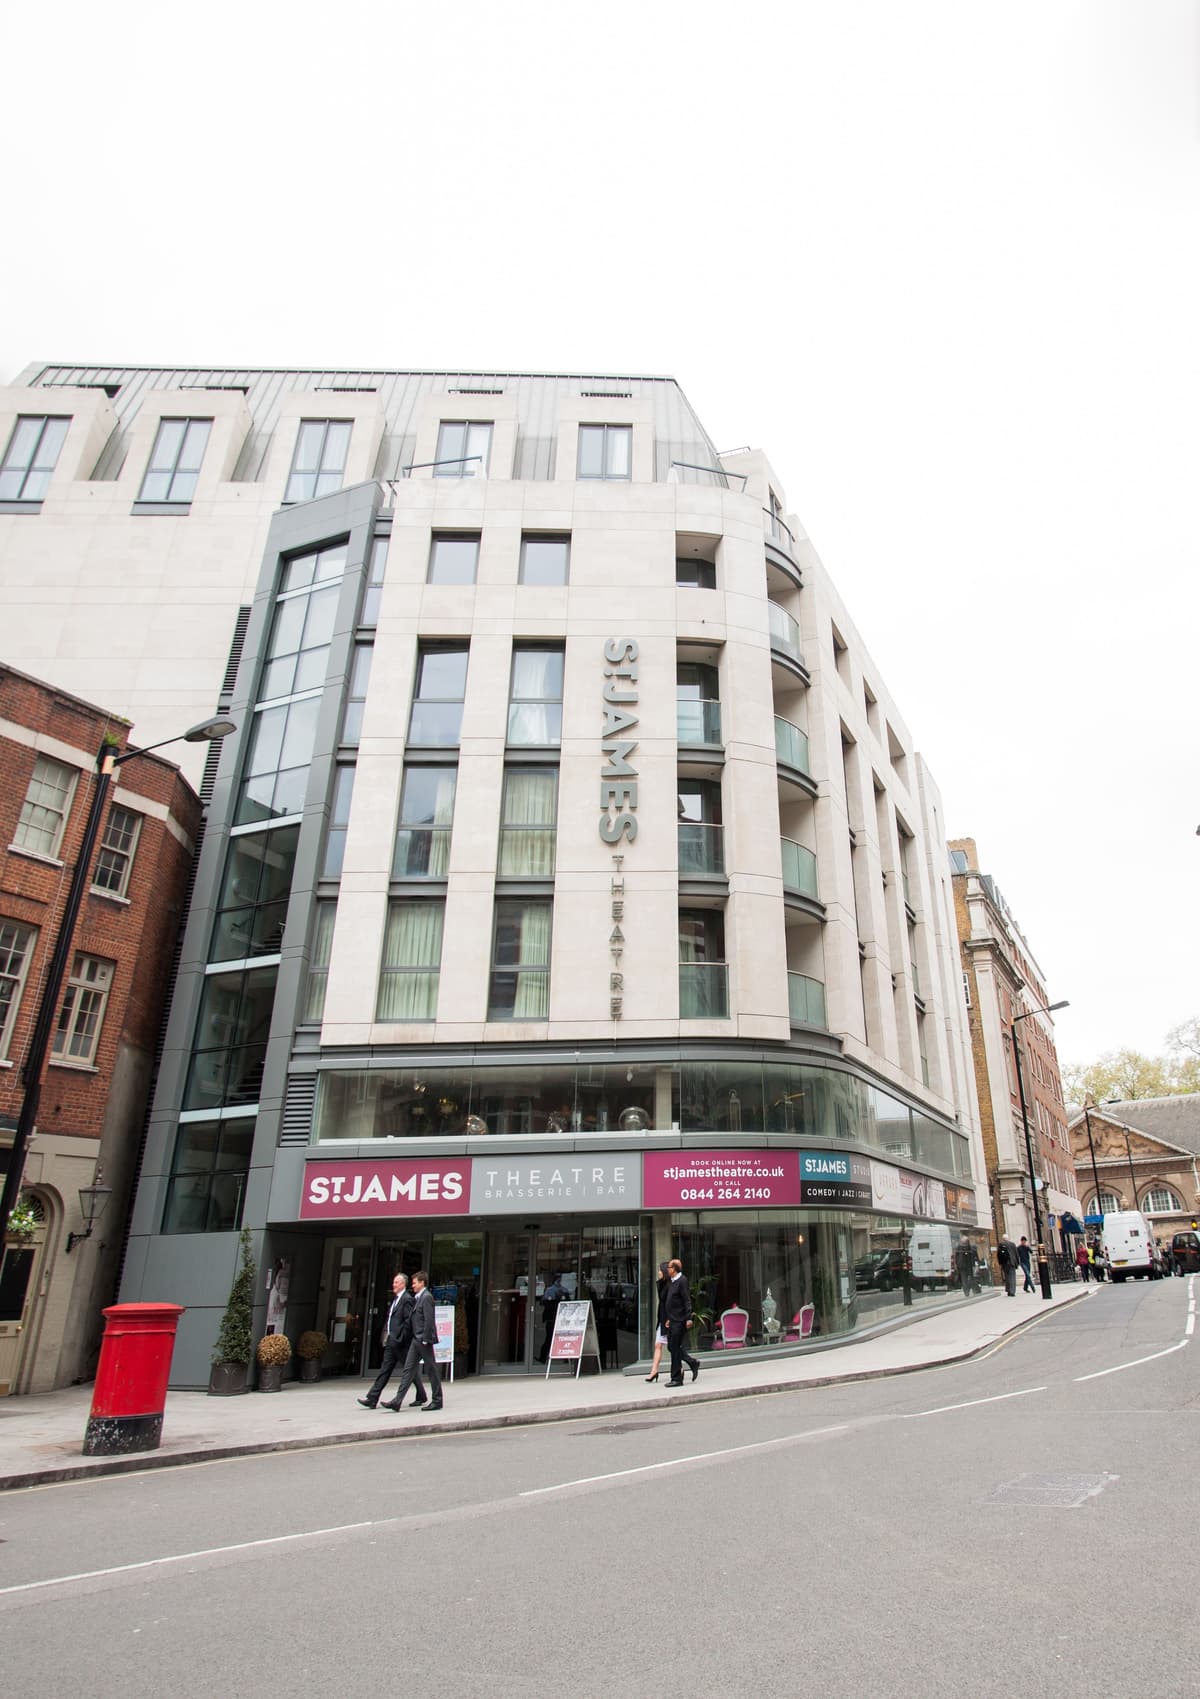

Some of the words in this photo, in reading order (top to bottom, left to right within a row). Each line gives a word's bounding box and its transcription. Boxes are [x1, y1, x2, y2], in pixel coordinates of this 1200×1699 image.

[608, 855, 625, 1021] THEATRE
[486, 1167, 625, 1187] THEATRE
[663, 1166, 784, 1180] stjamestheatre.co.uk
[485, 1187, 572, 1199] BRASSERIE
[597, 1185, 625, 1196] BAR
[681, 1188, 714, 1200] 0844
[717, 1188, 741, 1199] 264
[744, 1188, 771, 1199] 2140
[807, 1188, 836, 1197] COMEDY
[842, 1189, 855, 1198] JAZZ
